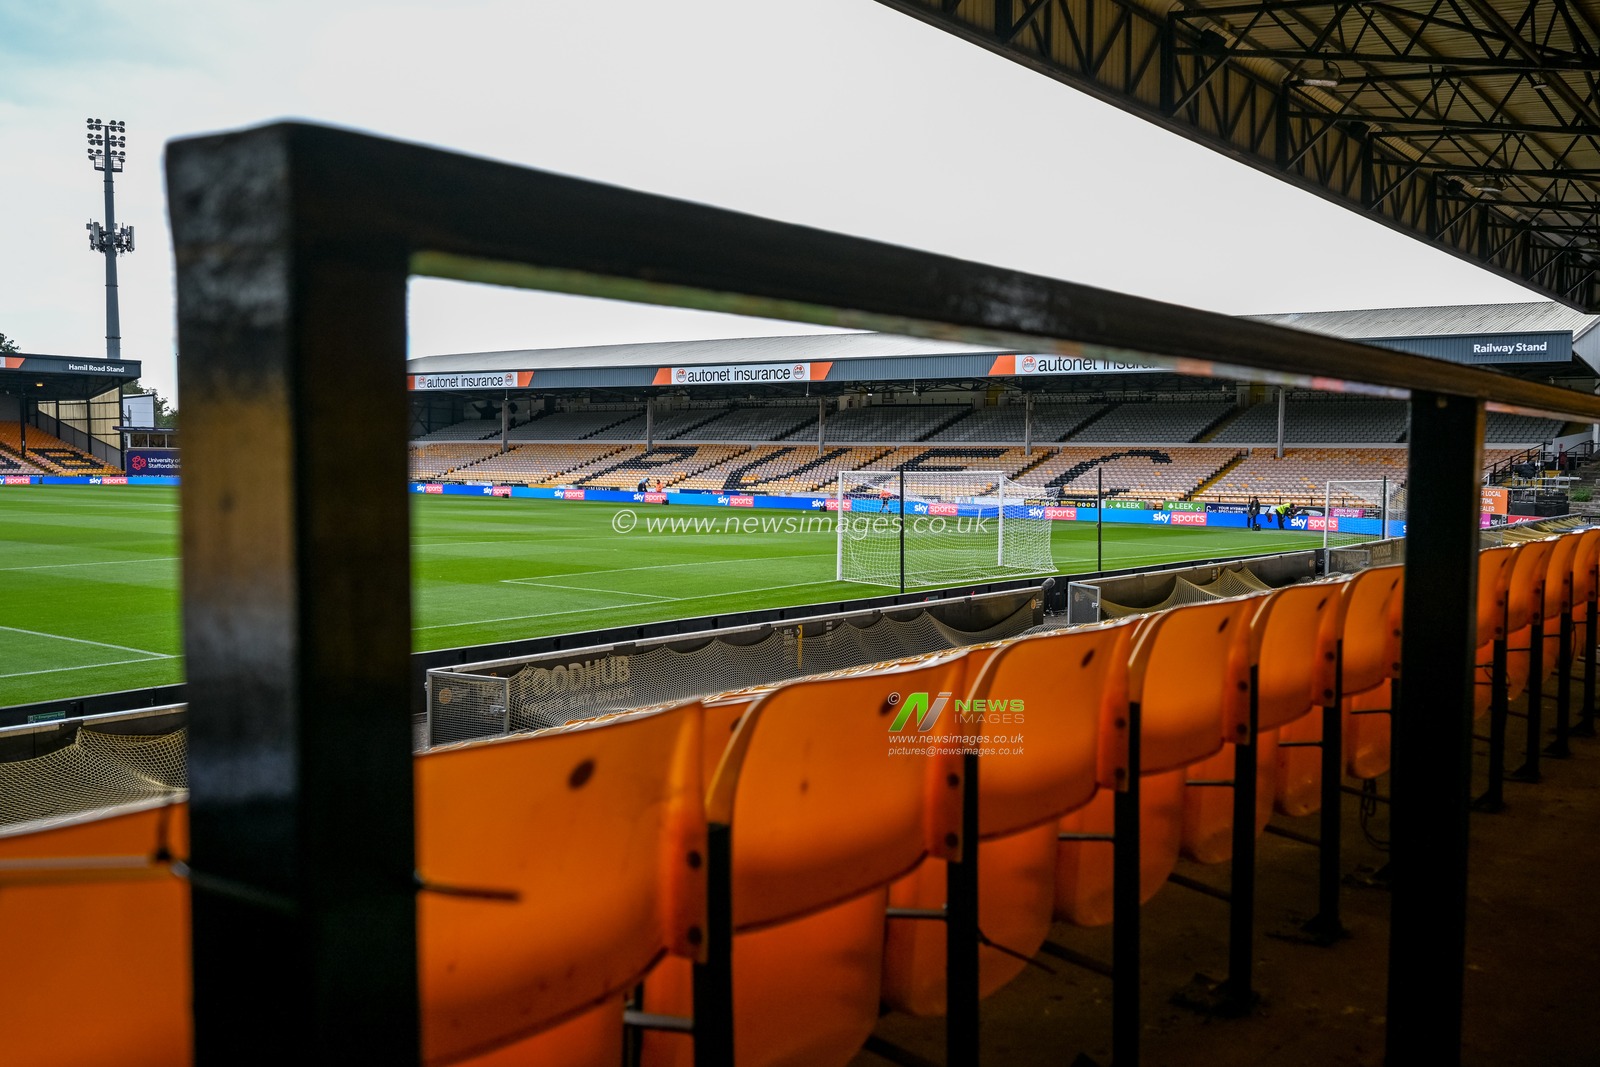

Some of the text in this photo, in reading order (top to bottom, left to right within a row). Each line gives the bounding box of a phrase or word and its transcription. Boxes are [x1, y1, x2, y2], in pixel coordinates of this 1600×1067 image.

[1473, 341, 1547, 354] Railway Stand
[68, 363, 125, 373] Hamil Road Stand
[1038, 356, 1097, 372] autonet
[687, 366, 791, 383] autonet insurance
[426, 375, 504, 388] autonet insurance
[89, 476, 127, 485] sky sports
[416, 484, 443, 493] sky sports
[483, 486, 512, 496] sky sports
[553, 489, 584, 499] sky sports
[633, 492, 667, 503] sky sports
[717, 495, 753, 506] sky sports
[811, 499, 850, 510] sky spots
[914, 503, 957, 515] sky sports
[1174, 502, 1194, 510] LEEK
[1028, 507, 1075, 520] sky sports
[1152, 511, 1205, 526] sky sports
[1290, 516, 1337, 530] sky spots
